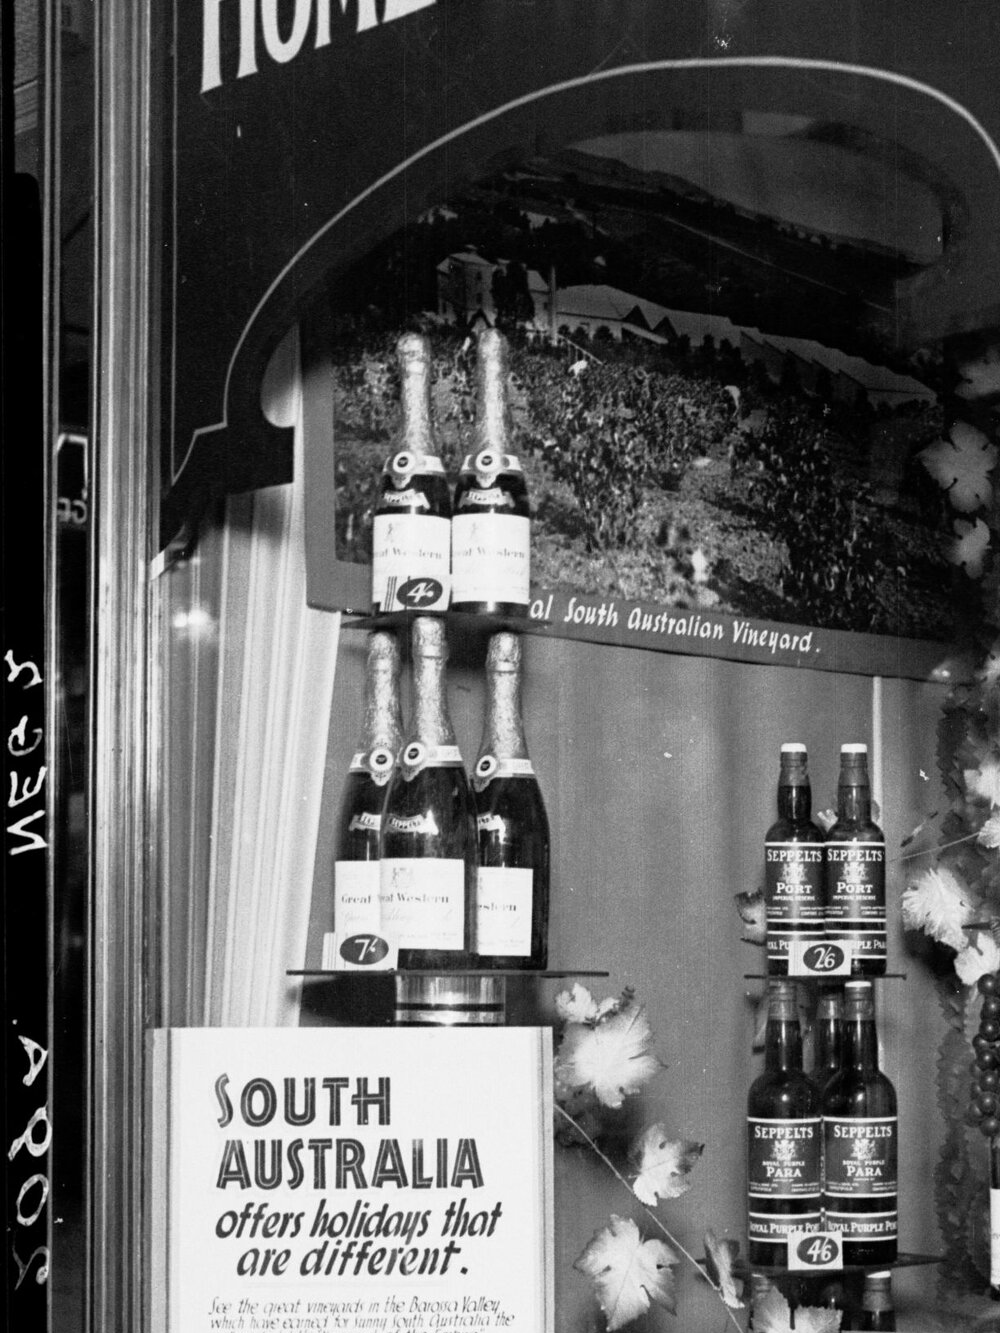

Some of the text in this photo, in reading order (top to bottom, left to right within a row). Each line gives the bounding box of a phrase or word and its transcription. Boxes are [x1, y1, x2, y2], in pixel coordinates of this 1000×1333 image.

[564, 597, 619, 628] South
[627, 606, 725, 641] Australian
[732, 619, 822, 655] Vineyard.
[767, 849, 822, 862] SEPPELTS
[776, 882, 813, 894] PORT
[836, 881, 874, 894] PORT
[214, 1072, 392, 1129] SOUTH
[754, 1125, 814, 1139] SEPPELTS
[834, 1125, 893, 1138] SEPPELTS
[215, 1137, 485, 1191] AUSTRALIA
[847, 1165, 883, 1177] PARA
[766, 1166, 802, 1178] PARA
[214, 1197, 503, 1246] offers holidays that
[850, 1222, 884, 1233] PURPLE
[236, 1239, 470, 1277] are different.
[208, 1296, 232, 1315] See
[238, 1297, 259, 1314] the
[262, 1298, 302, 1319] great
[306, 1298, 364, 1320] vineyards
[367, 1299, 380, 1314] in
[384, 1295, 406, 1314] the
[408, 1296, 459, 1314] Barossa
[210, 1316, 245, 1331] which
[249, 1316, 280, 1331] have
[281, 1315, 330, 1332] earned
[428, 1313, 491, 1331] Australia
[494, 1311, 516, 1330] the
